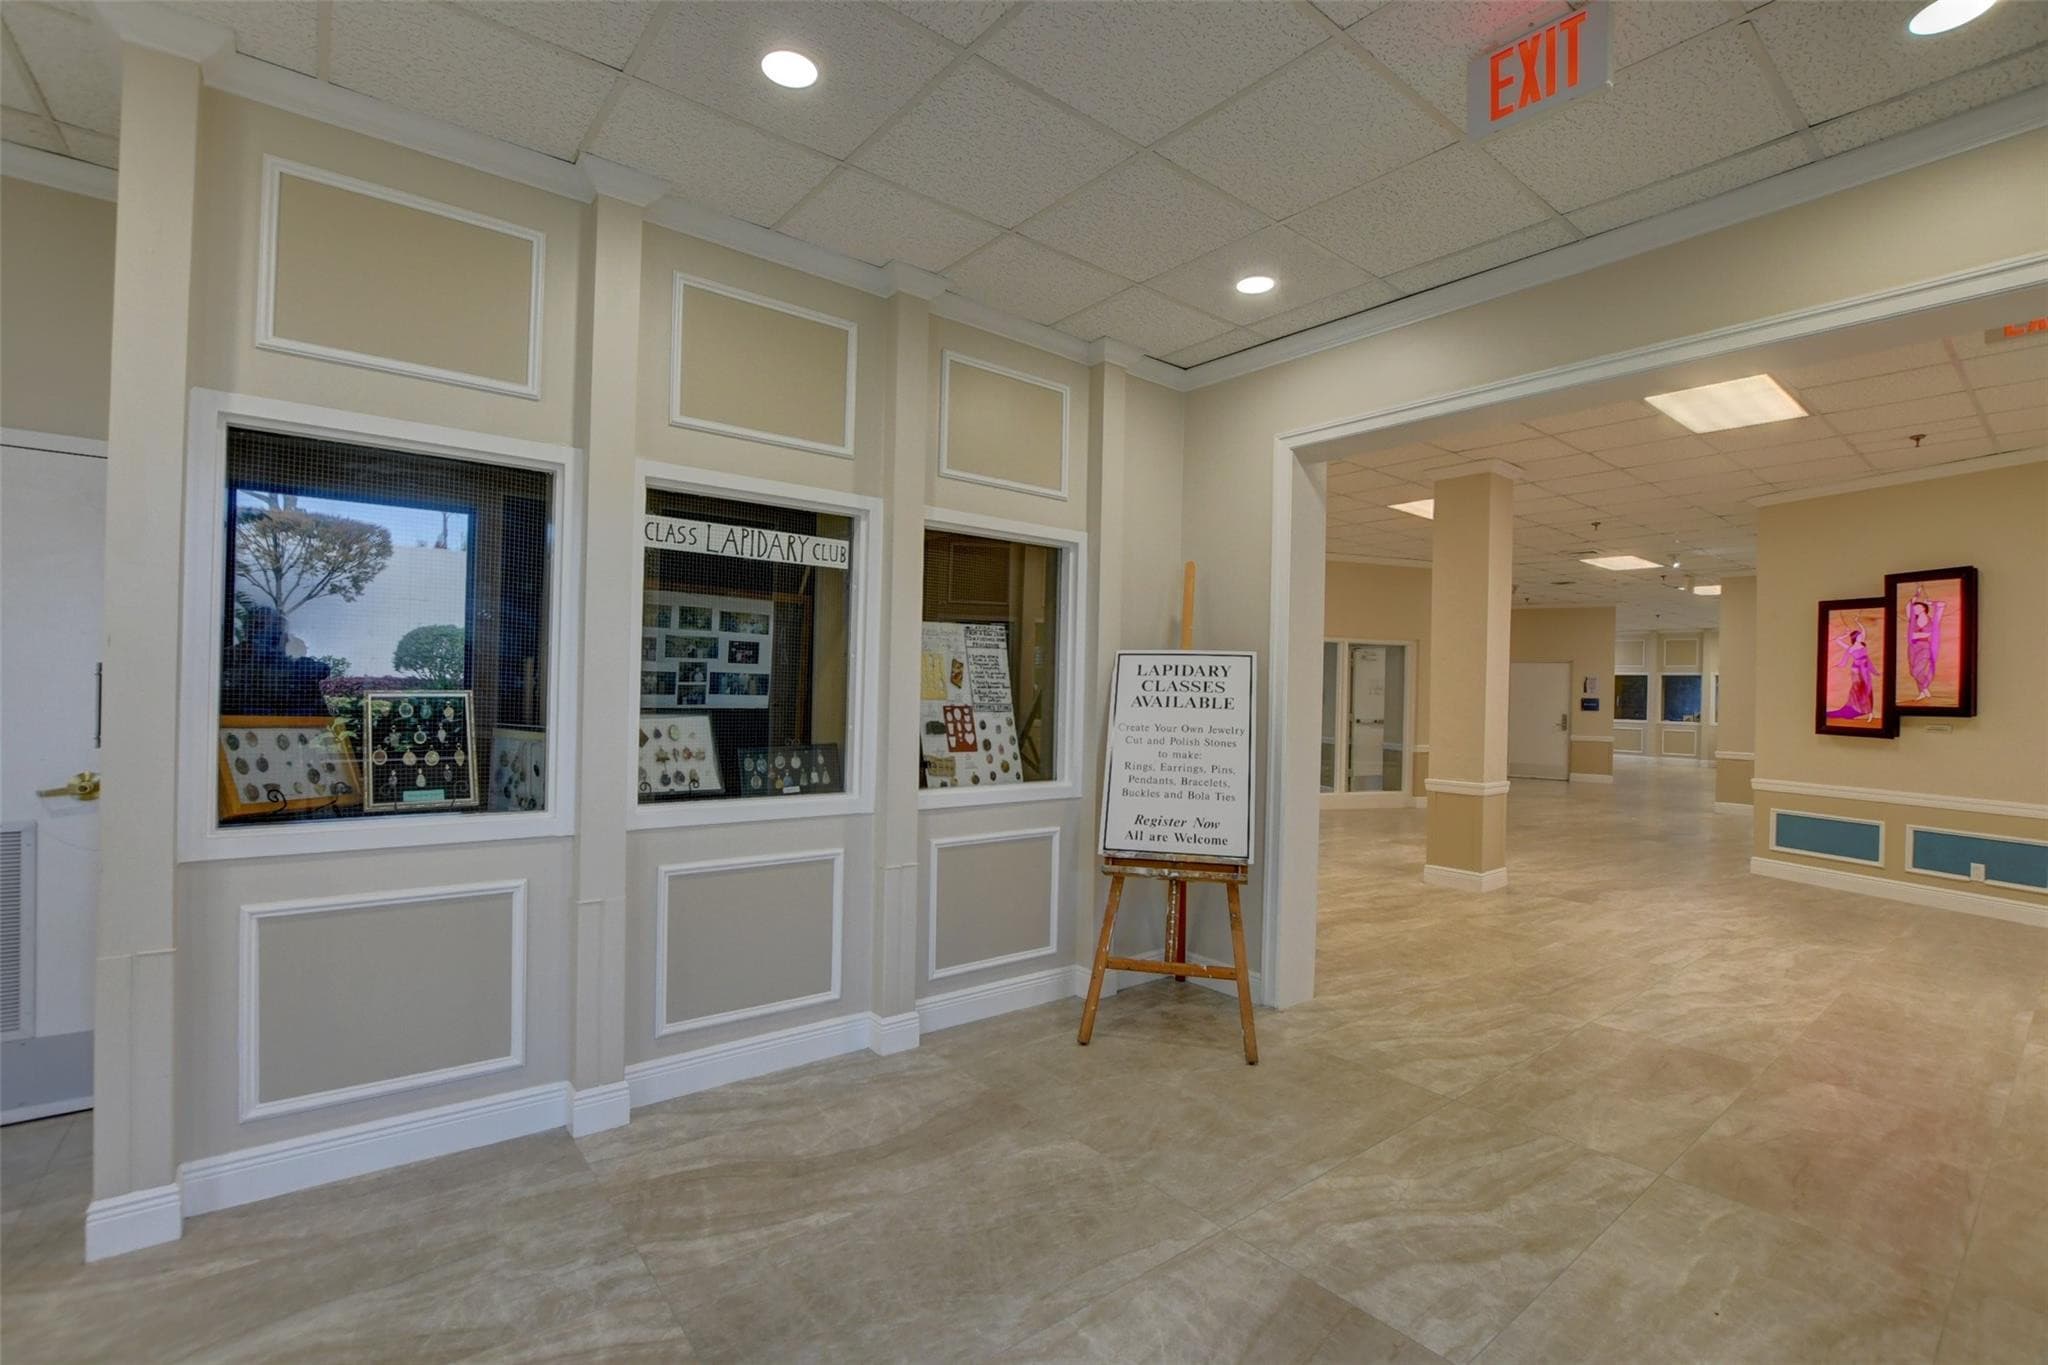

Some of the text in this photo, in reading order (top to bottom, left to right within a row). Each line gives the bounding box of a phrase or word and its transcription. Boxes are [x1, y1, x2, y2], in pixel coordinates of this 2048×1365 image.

[1489, 11, 1587, 121] EXIT
[644, 521, 847, 564] CLASS LAPIDARY CLUB
[1137, 664, 1231, 678] LAPIDARY
[1141, 680, 1226, 693] CLASSES
[1131, 696, 1235, 710] AVAILABLE
[1118, 722, 1245, 737] Create Your Own Jewelry
[1125, 736, 1237, 748] Cut and Polish Stones
[1172, 751, 1202, 760] make:
[1122, 788, 1236, 802] Buckles and Bola Ties
[1134, 814, 1221, 829] Register Now
[1125, 830, 1228, 846] All are Welcome
